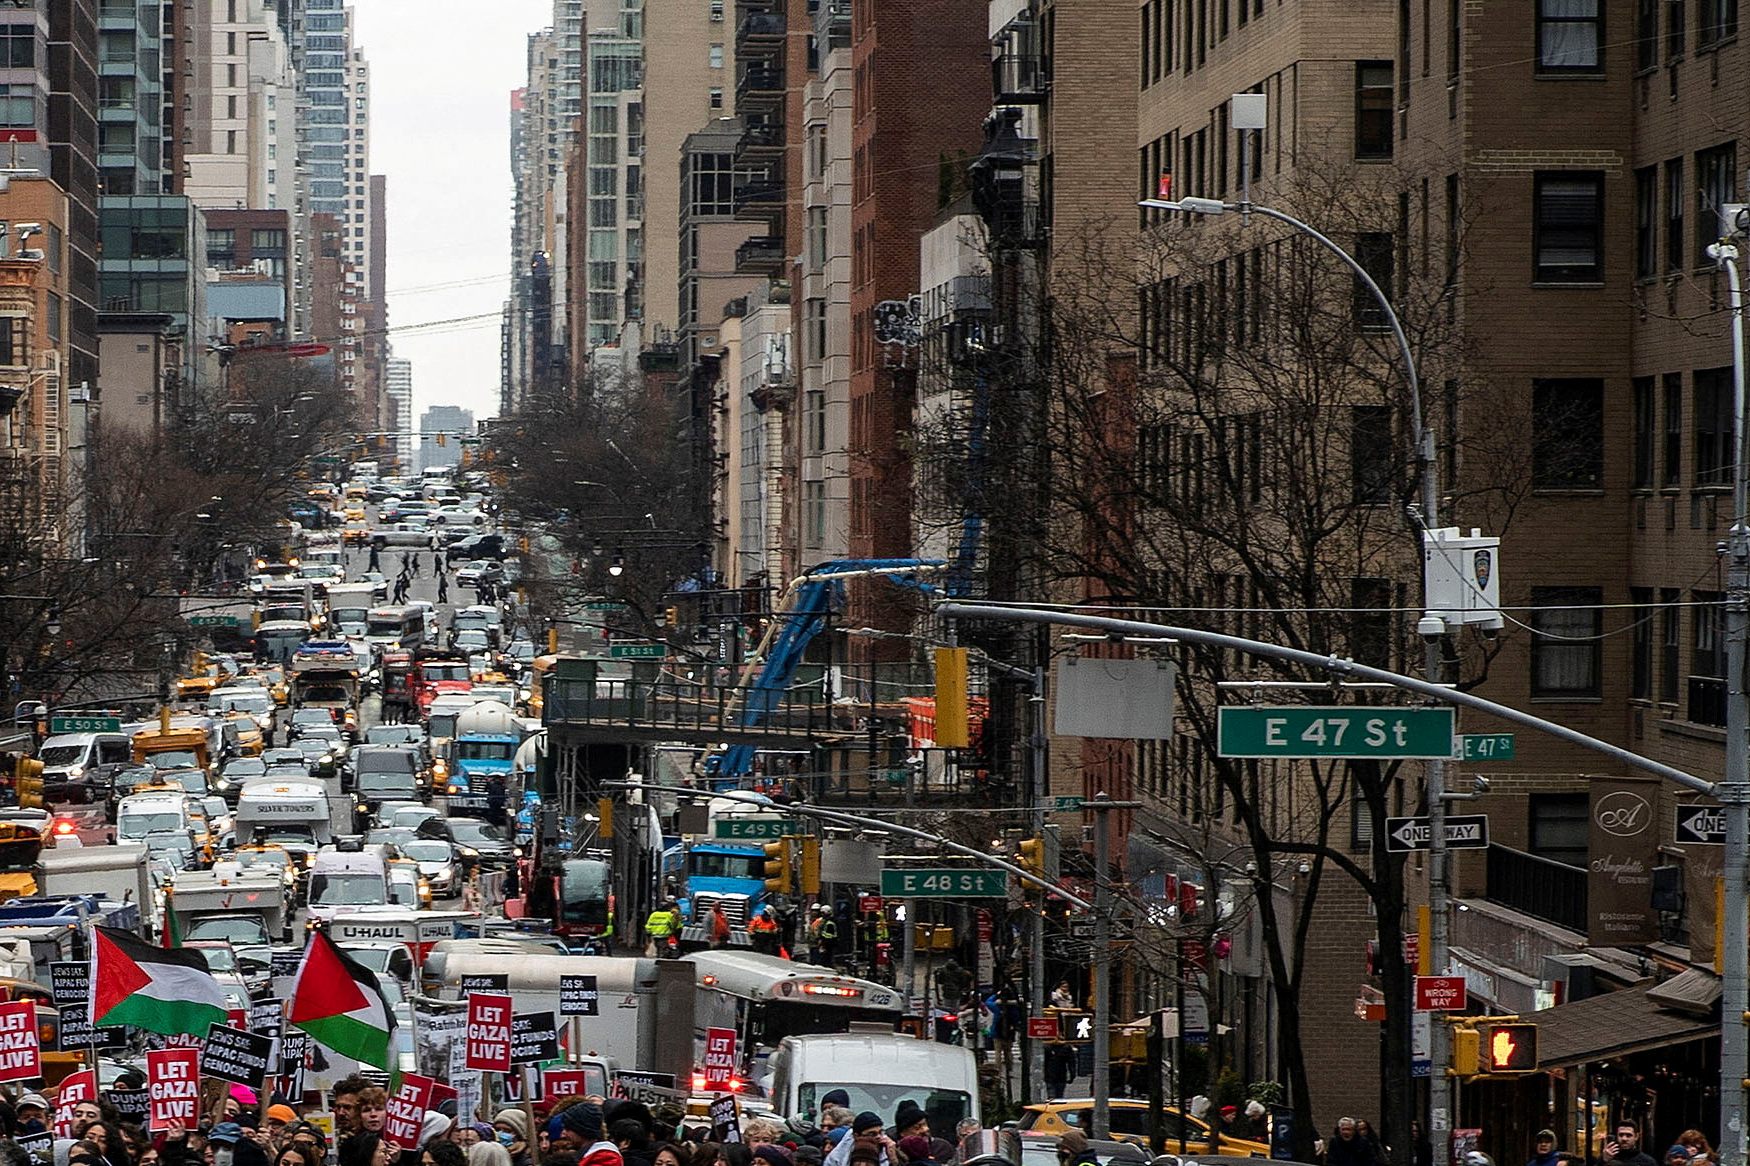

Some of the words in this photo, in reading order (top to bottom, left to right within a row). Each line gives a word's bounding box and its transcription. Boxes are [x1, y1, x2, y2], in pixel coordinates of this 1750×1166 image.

[64, 720, 72, 730] E
[74, 720, 92, 730] 50
[94, 720, 109, 730] St
[1265, 718, 1288, 746] E
[1301, 718, 1350, 746] 47
[1365, 719, 1408, 747] St
[1464, 739, 1473, 757] E
[1477, 738, 1496, 757] 47
[1601, 803, 1644, 828] A
[731, 824, 740, 835] E
[746, 823, 767, 835] 49
[772, 823, 791, 835] St
[1402, 827, 1429, 842] ONE
[1445, 825, 1475, 840] WAY
[1694, 817, 1727, 833] ONE
[903, 875, 917, 891] E
[923, 875, 952, 891] 48
[960, 876, 985, 891] St
[1424, 989, 1458, 998] WRONG
[1431, 998, 1452, 1007] WAY
[475, 1005, 504, 1022] LET
[0, 1013, 28, 1032] LET
[210, 1032, 234, 1045] JEWS
[468, 1023, 510, 1042] GAZA
[521, 1029, 556, 1044] FUNDS
[471, 1043, 506, 1060] LIVE
[711, 1038, 730, 1051] LET
[0, 1051, 35, 1070] LIVE
[206, 1043, 237, 1060] AIPAC
[238, 1051, 266, 1069] FUNDS
[706, 1054, 733, 1067] GAZA
[156, 1061, 190, 1080] LET
[203, 1057, 251, 1080] GENOCIDE
[707, 1069, 729, 1082] LIVE
[60, 1083, 86, 1104] LET
[151, 1081, 199, 1100] GAZA
[394, 1083, 422, 1102] LET
[552, 1080, 579, 1095] LET
[111, 1093, 150, 1104] DUMP
[156, 1101, 195, 1120] LIVE
[386, 1098, 423, 1122] GAZA
[386, 1119, 416, 1140] LIVE
